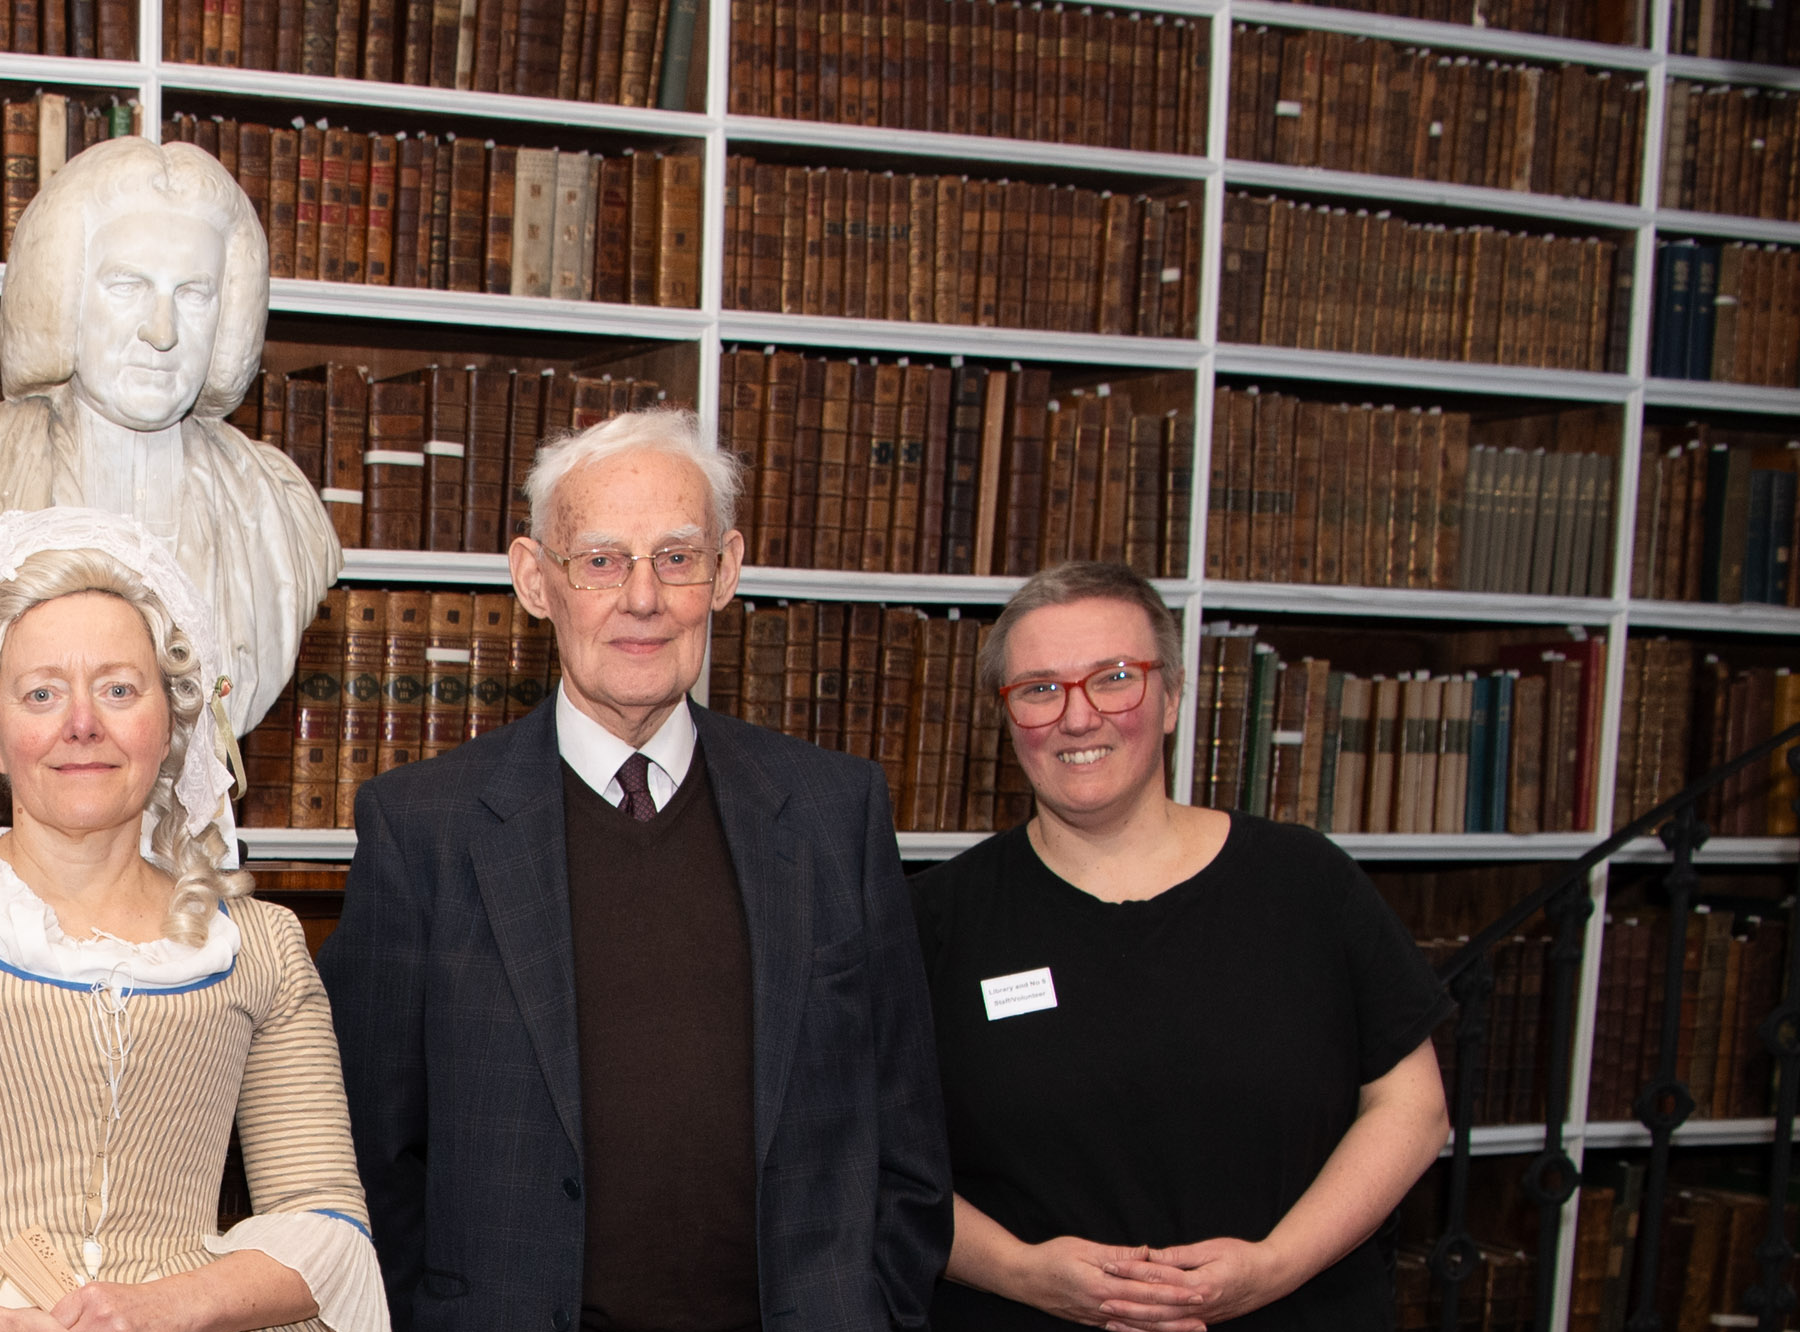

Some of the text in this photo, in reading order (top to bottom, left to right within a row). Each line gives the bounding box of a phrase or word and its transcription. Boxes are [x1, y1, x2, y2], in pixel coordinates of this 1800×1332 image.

[355, 679, 372, 687] VOL
[396, 681, 413, 689] VOL
[440, 682, 457, 690] VOL
[399, 691, 409, 699] III
[988, 986, 1014, 995] Library
[1015, 982, 1029, 990] and
[994, 991, 1046, 1006] Staff/Volunteer
